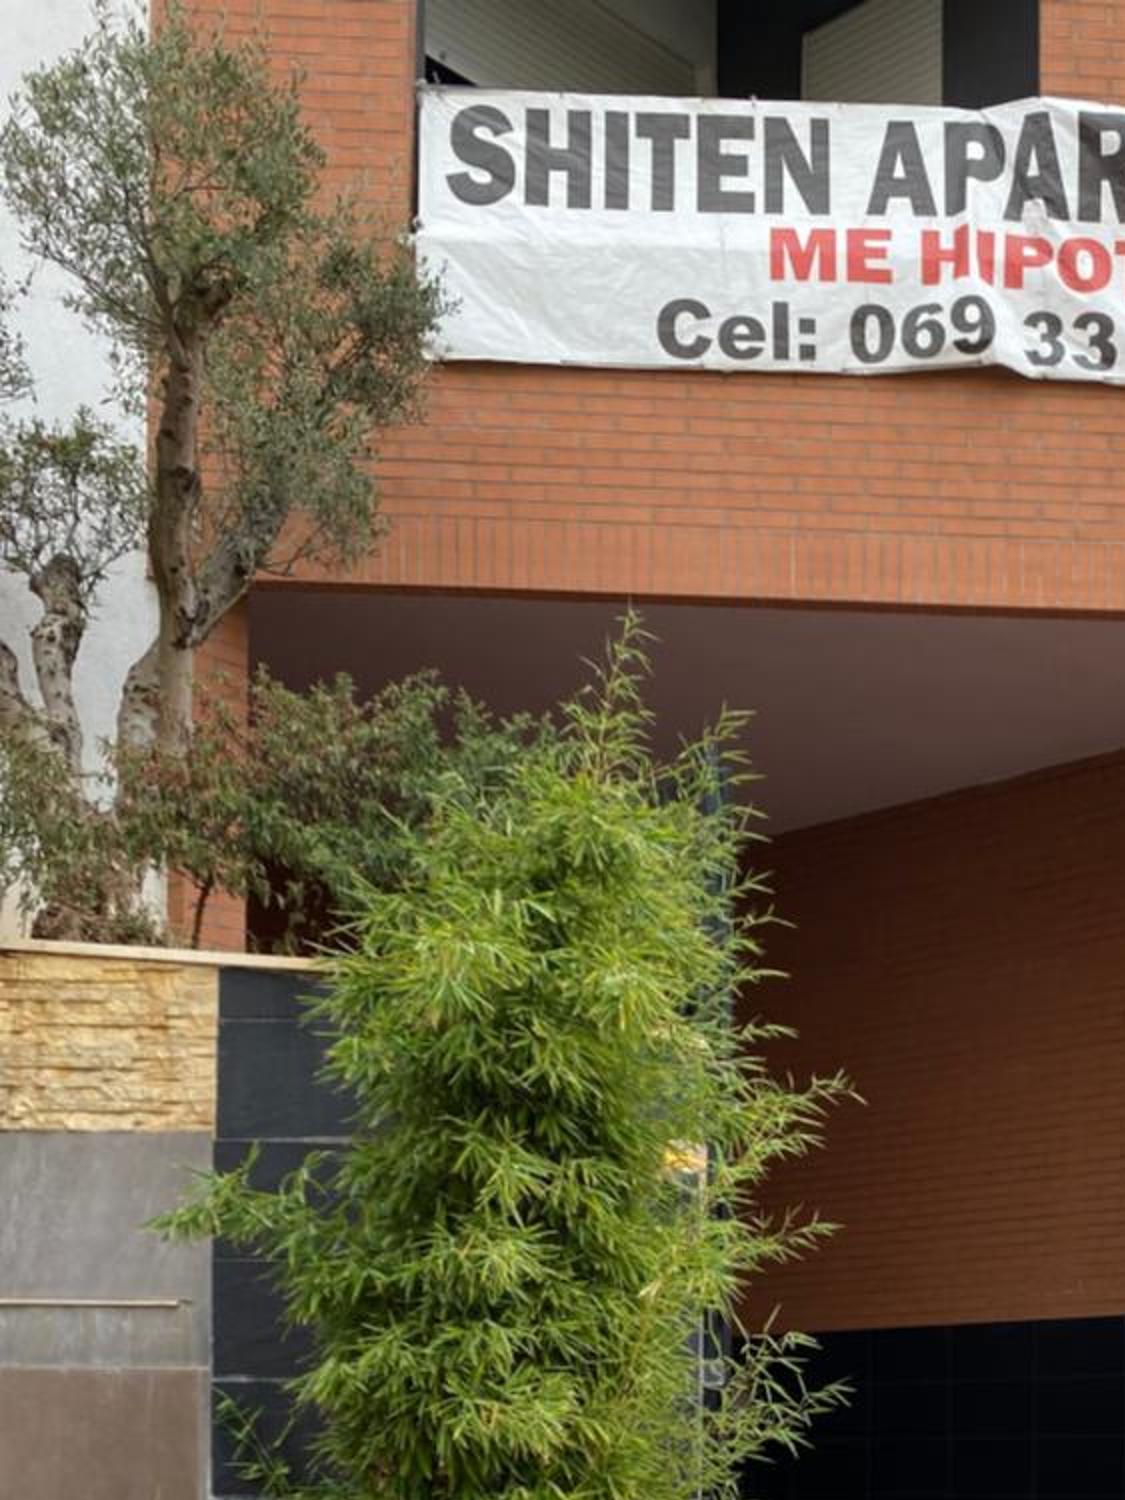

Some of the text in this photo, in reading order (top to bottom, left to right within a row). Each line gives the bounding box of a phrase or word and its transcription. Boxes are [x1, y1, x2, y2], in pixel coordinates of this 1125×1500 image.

[446, 103, 831, 216] SHITEN
[769, 227, 893, 285] ME
[656, 299, 818, 361] Cel:
[849, 295, 996, 364] 069
[1024, 311, 1118, 370] 33
